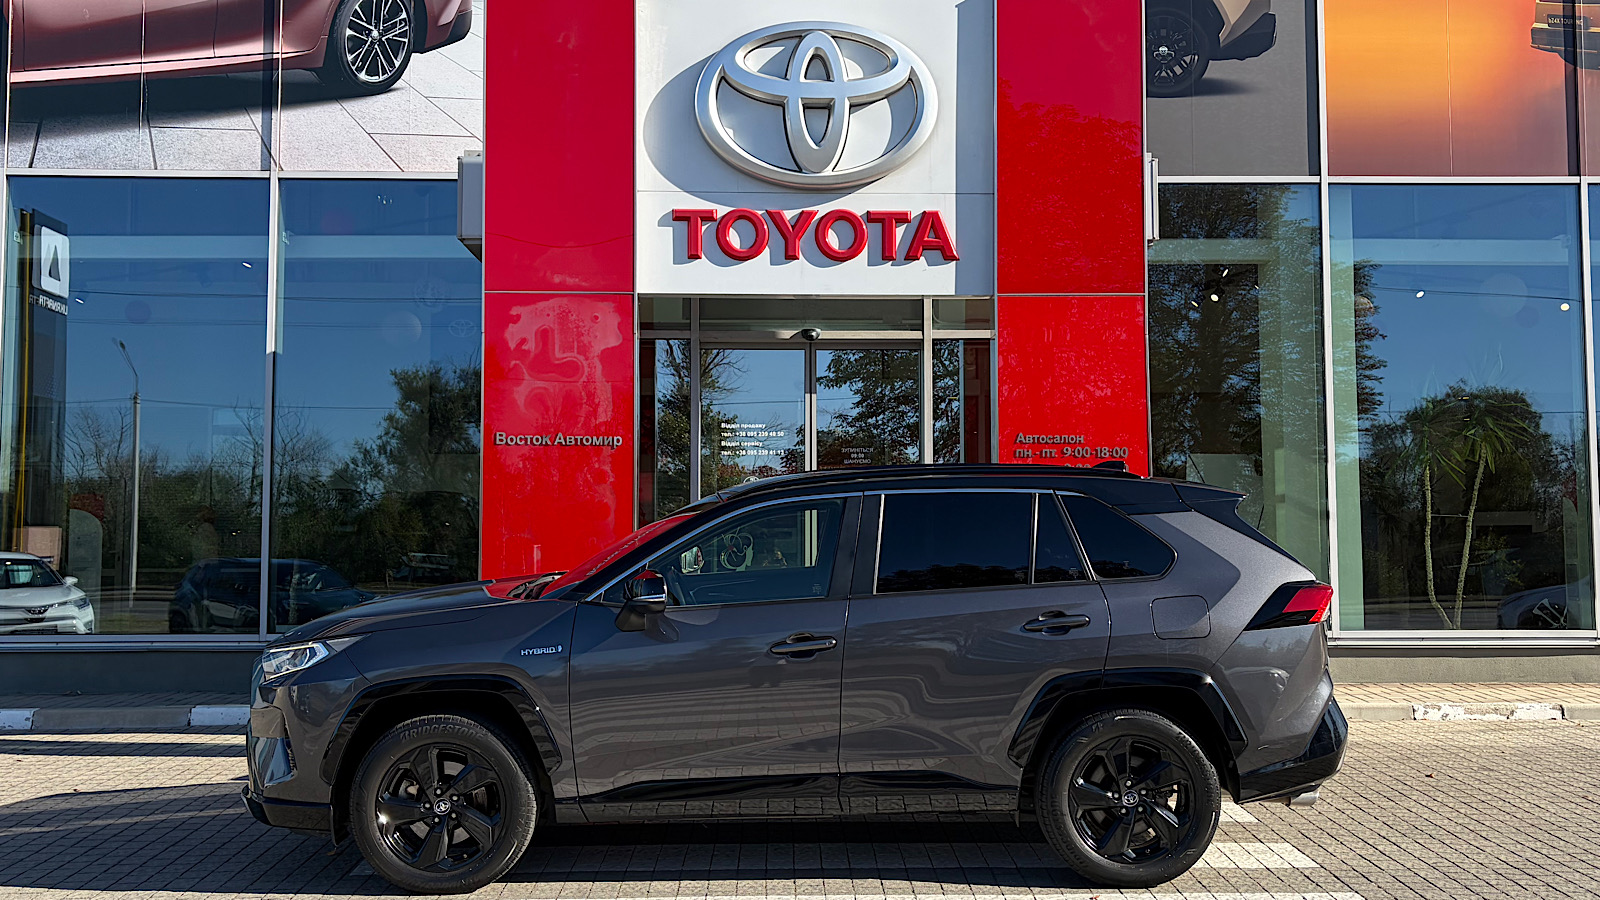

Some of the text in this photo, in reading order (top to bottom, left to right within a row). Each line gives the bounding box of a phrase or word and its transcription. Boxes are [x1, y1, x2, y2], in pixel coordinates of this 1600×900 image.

[672, 208, 960, 262] TOYOTA
[495, 432, 622, 448] Восток Автомир
[1016, 433, 1084, 443] Автосалон
[1063, 446, 1129, 458] 9:00-18:00
[521, 646, 557, 656] HYBRID
